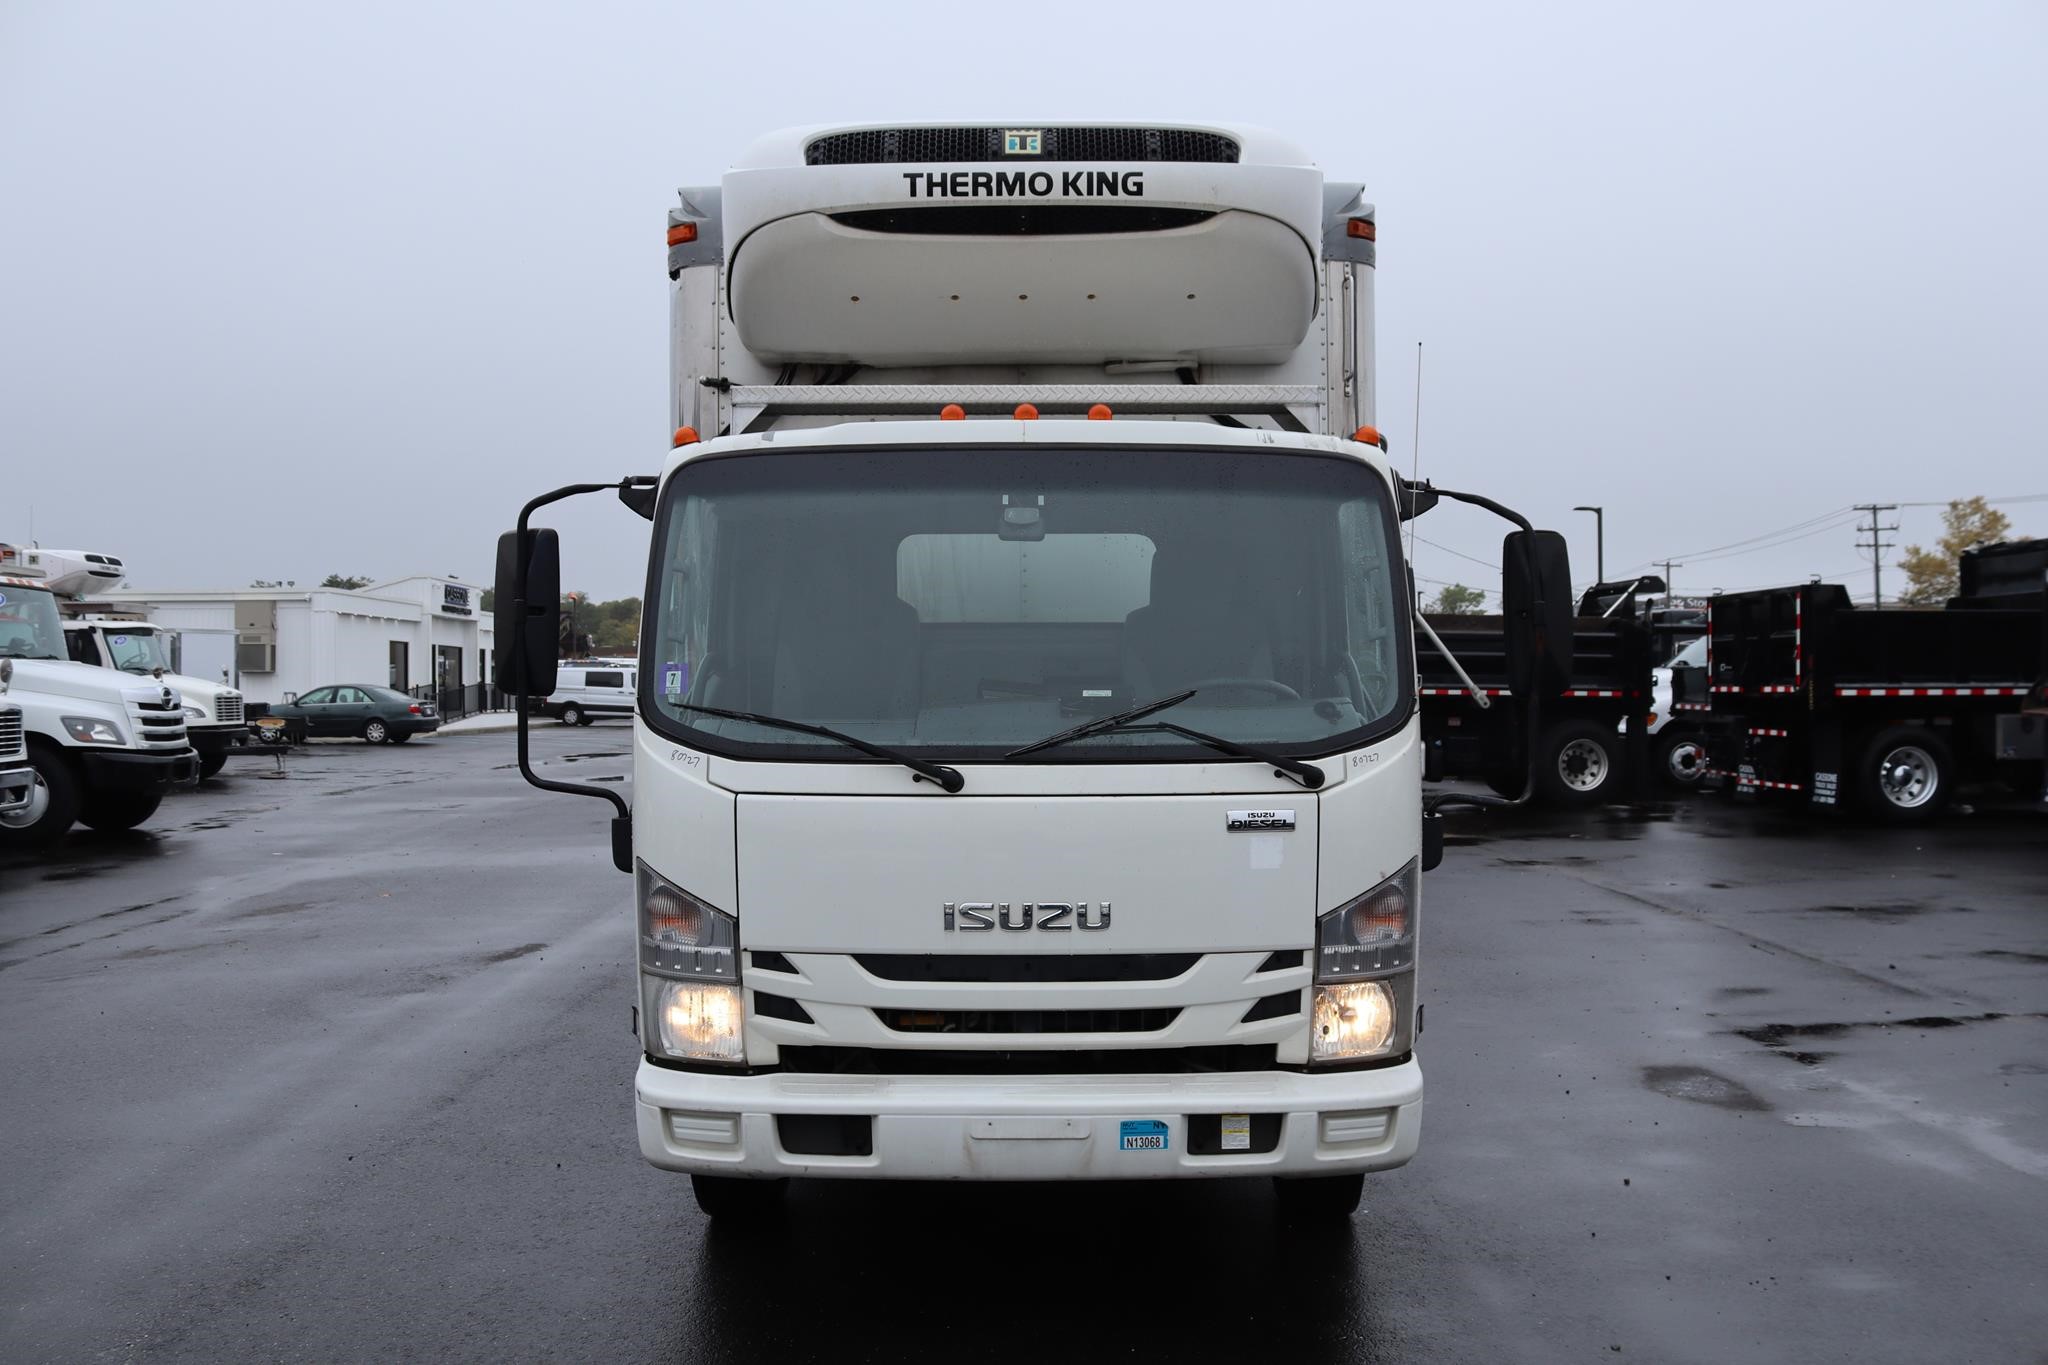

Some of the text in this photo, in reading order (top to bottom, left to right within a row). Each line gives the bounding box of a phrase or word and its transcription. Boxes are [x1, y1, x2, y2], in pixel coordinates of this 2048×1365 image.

[903, 171, 1143, 197] THERMO KING
[670, 673, 676, 685] 7
[1231, 819, 1292, 829] DIESEL
[944, 902, 1111, 931] ISUZU
[1126, 1137, 1160, 1148] N13068
